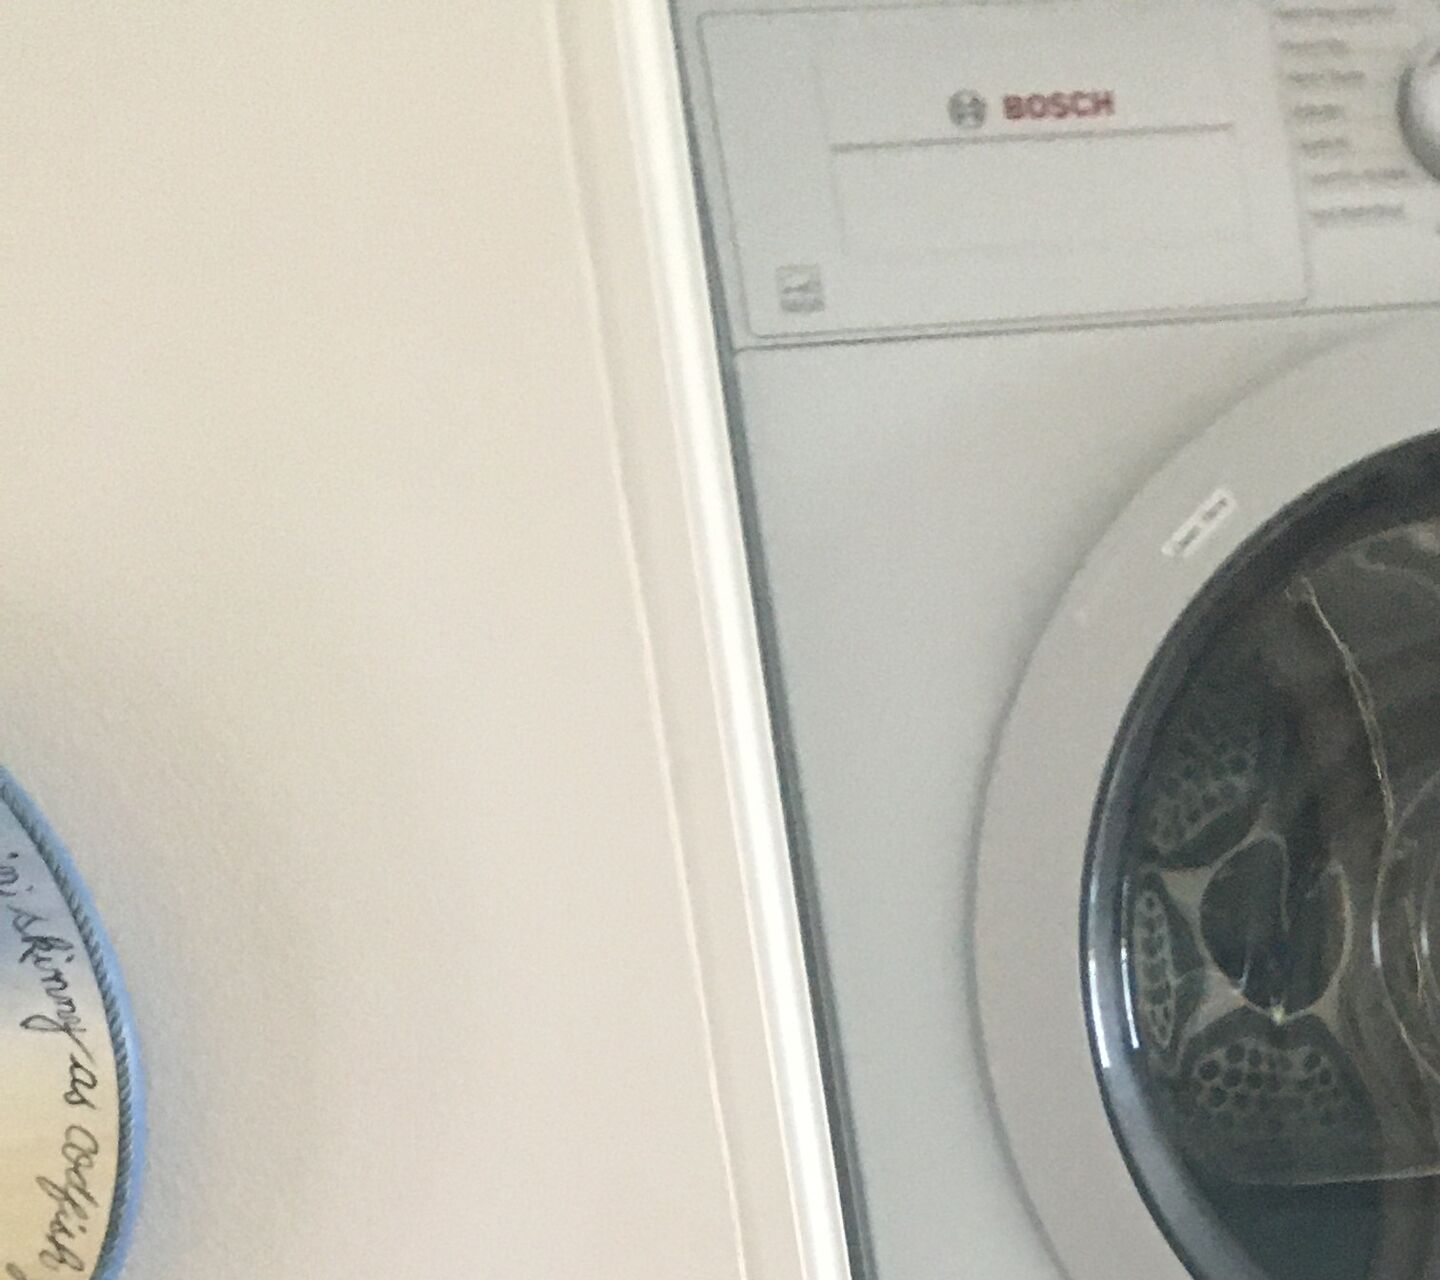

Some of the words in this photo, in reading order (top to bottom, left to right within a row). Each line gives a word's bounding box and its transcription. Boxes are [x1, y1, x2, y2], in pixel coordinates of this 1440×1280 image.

[1003, 89, 1115, 120] BOSCH
[7, 903, 95, 1062] skinny
[64, 1054, 98, 1110] as
[36, 1125, 99, 1272] codfish
